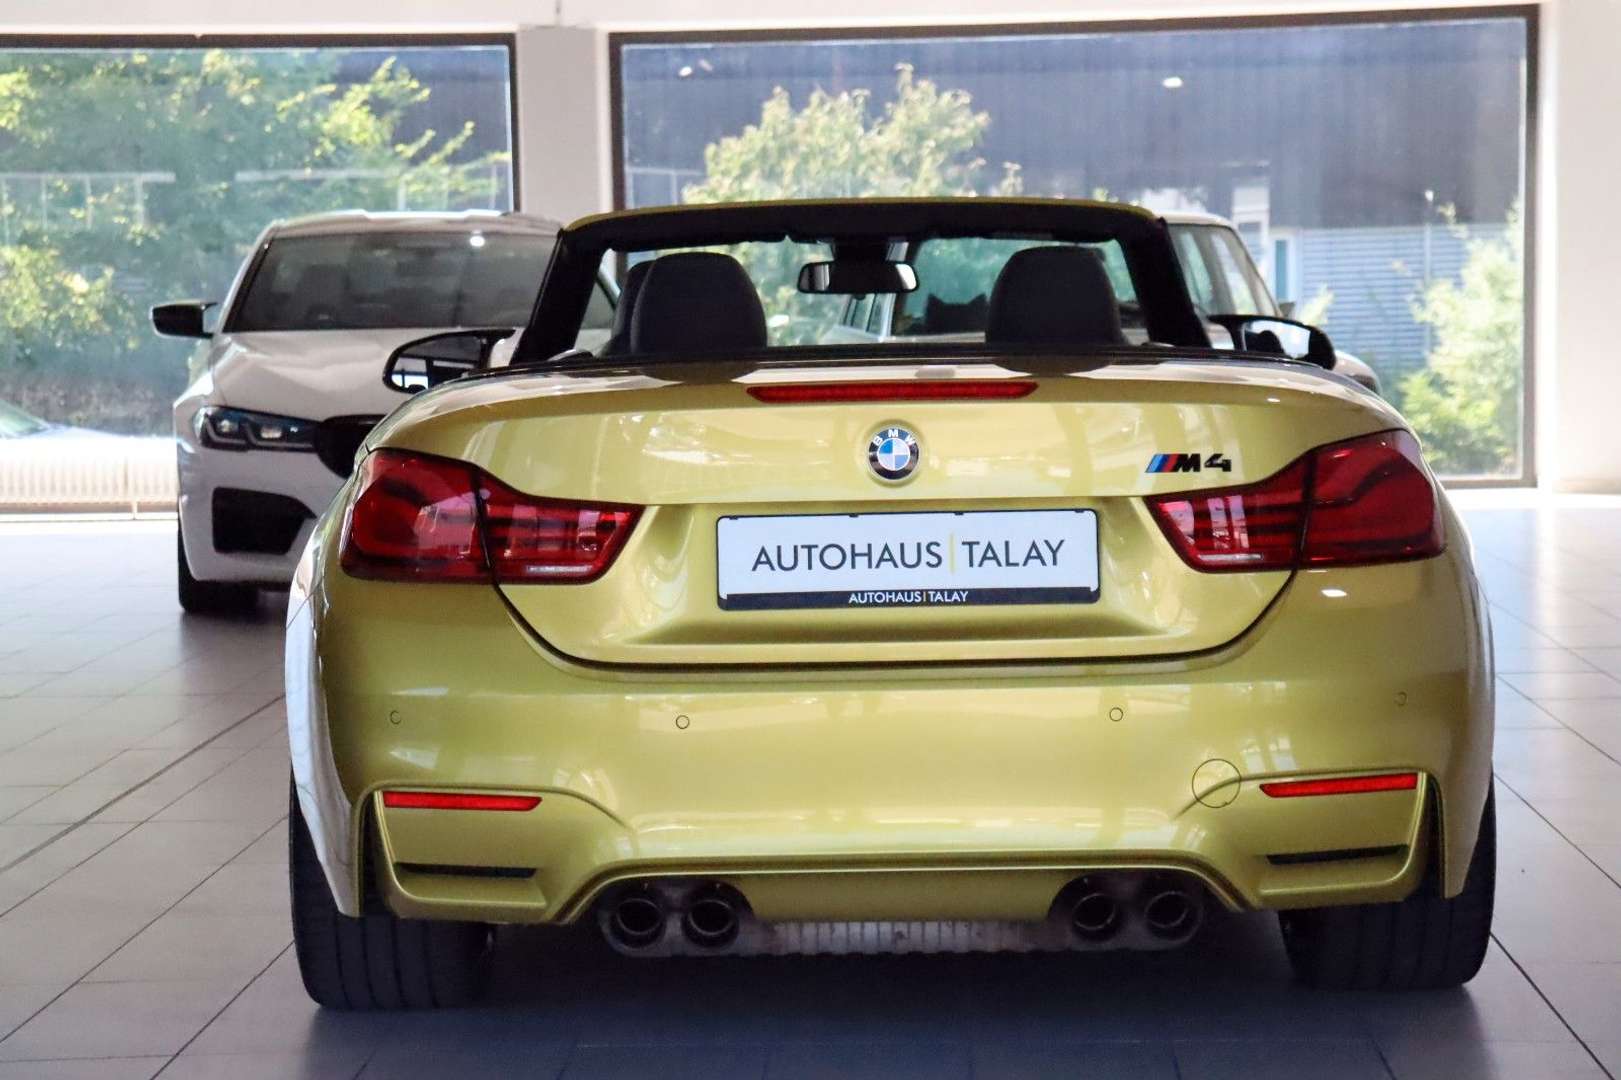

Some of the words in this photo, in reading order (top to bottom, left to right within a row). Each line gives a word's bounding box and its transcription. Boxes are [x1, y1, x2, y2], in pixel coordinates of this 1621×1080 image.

[872, 428, 916, 446] BMW
[1173, 453, 1232, 473] M4
[751, 541, 943, 572] AUTOHAUS
[961, 538, 1065, 569] TALAY
[848, 590, 923, 604] AUTOHAUS
[927, 590, 969, 603] TALAY
